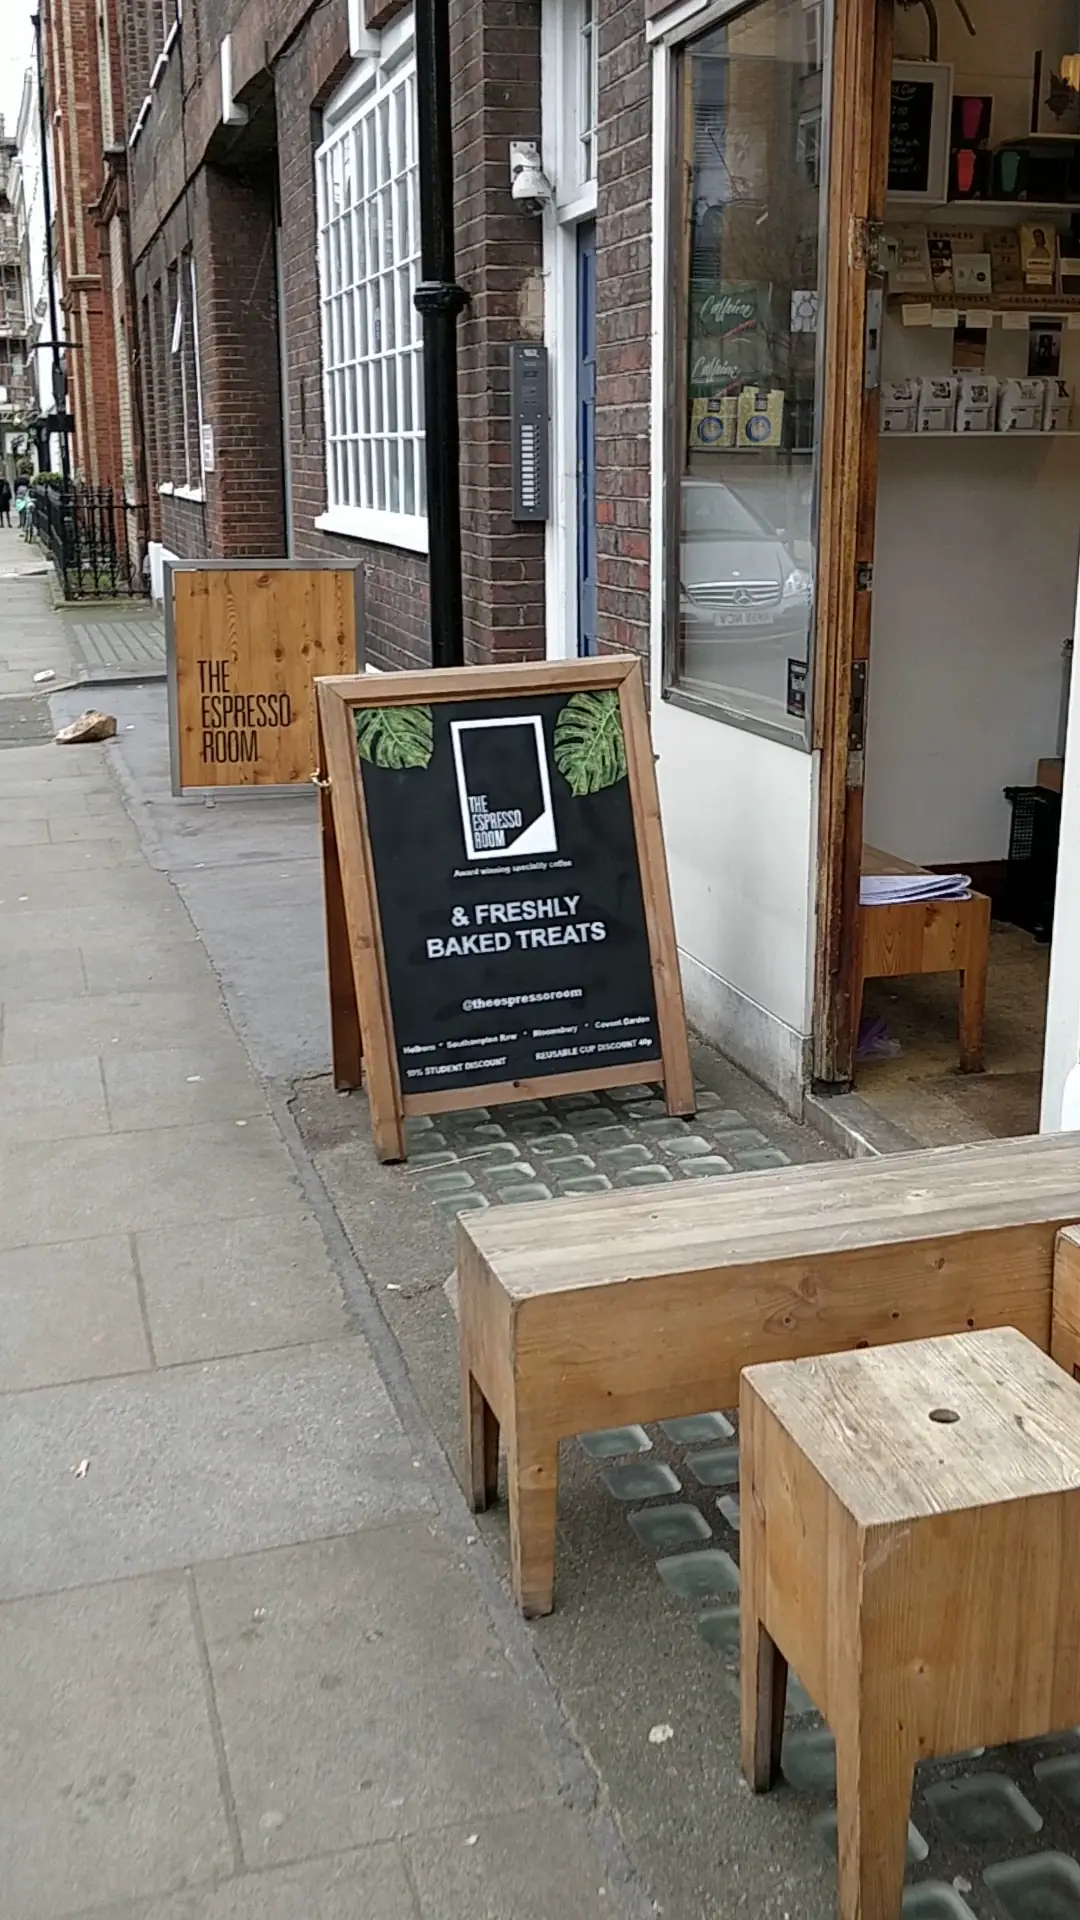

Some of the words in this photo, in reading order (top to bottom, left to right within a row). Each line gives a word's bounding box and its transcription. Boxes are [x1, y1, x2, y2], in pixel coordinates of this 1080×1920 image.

[701, 295, 754, 322] Caffeine
[197, 660, 230, 693] THE
[201, 693, 291, 728] ESPRESSO
[202, 729, 258, 763] ROOM
[468, 795, 489, 813] THE
[472, 809, 523, 832] ESPRESSO
[474, 830, 506, 849] ROOM
[453, 867, 480, 878] Award
[481, 864, 511, 876] winning
[549, 858, 573, 869] coffee
[451, 906, 470, 927] &
[474, 895, 580, 925] FRESHLY
[426, 932, 511, 958] BAKED
[515, 921, 606, 949] TREATS
[462, 987, 583, 1012] @theespressoroom
[446, 1035, 499, 1049] Southampton
[499, 1033, 518, 1042] Row
[532, 1025, 578, 1038] Bloomsbury
[594, 1019, 622, 1029] Covent
[623, 1015, 651, 1026] Garden
[535, 1046, 579, 1060] REUSABLE
[579, 1044, 596, 1054] CUP
[597, 1038, 638, 1052] DISCOUNT
[406, 1068, 424, 1078] 10%
[424, 1062, 464, 1076] STUDENT
[464, 1056, 507, 1070] DISCOUNT
